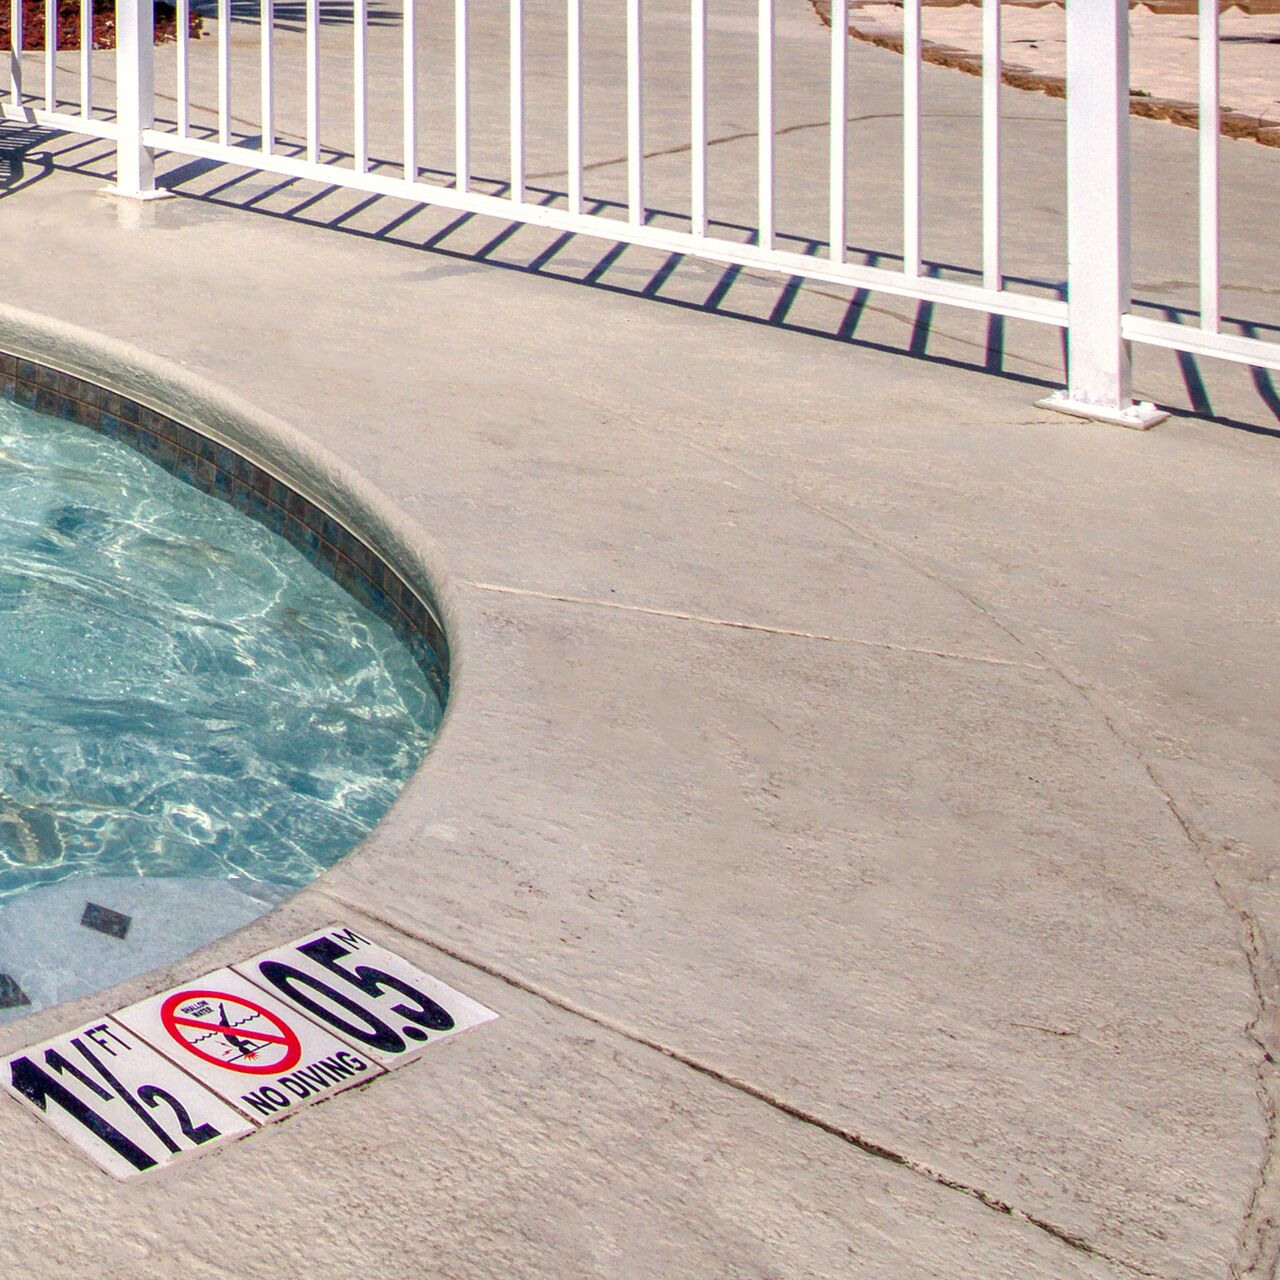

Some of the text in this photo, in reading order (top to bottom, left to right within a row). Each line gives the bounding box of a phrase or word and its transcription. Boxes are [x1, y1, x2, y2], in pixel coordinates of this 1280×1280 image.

[259, 927, 455, 1054] 0.5 M
[83, 1023, 132, 1057] FT
[241, 1051, 368, 1116] NO DIVING
